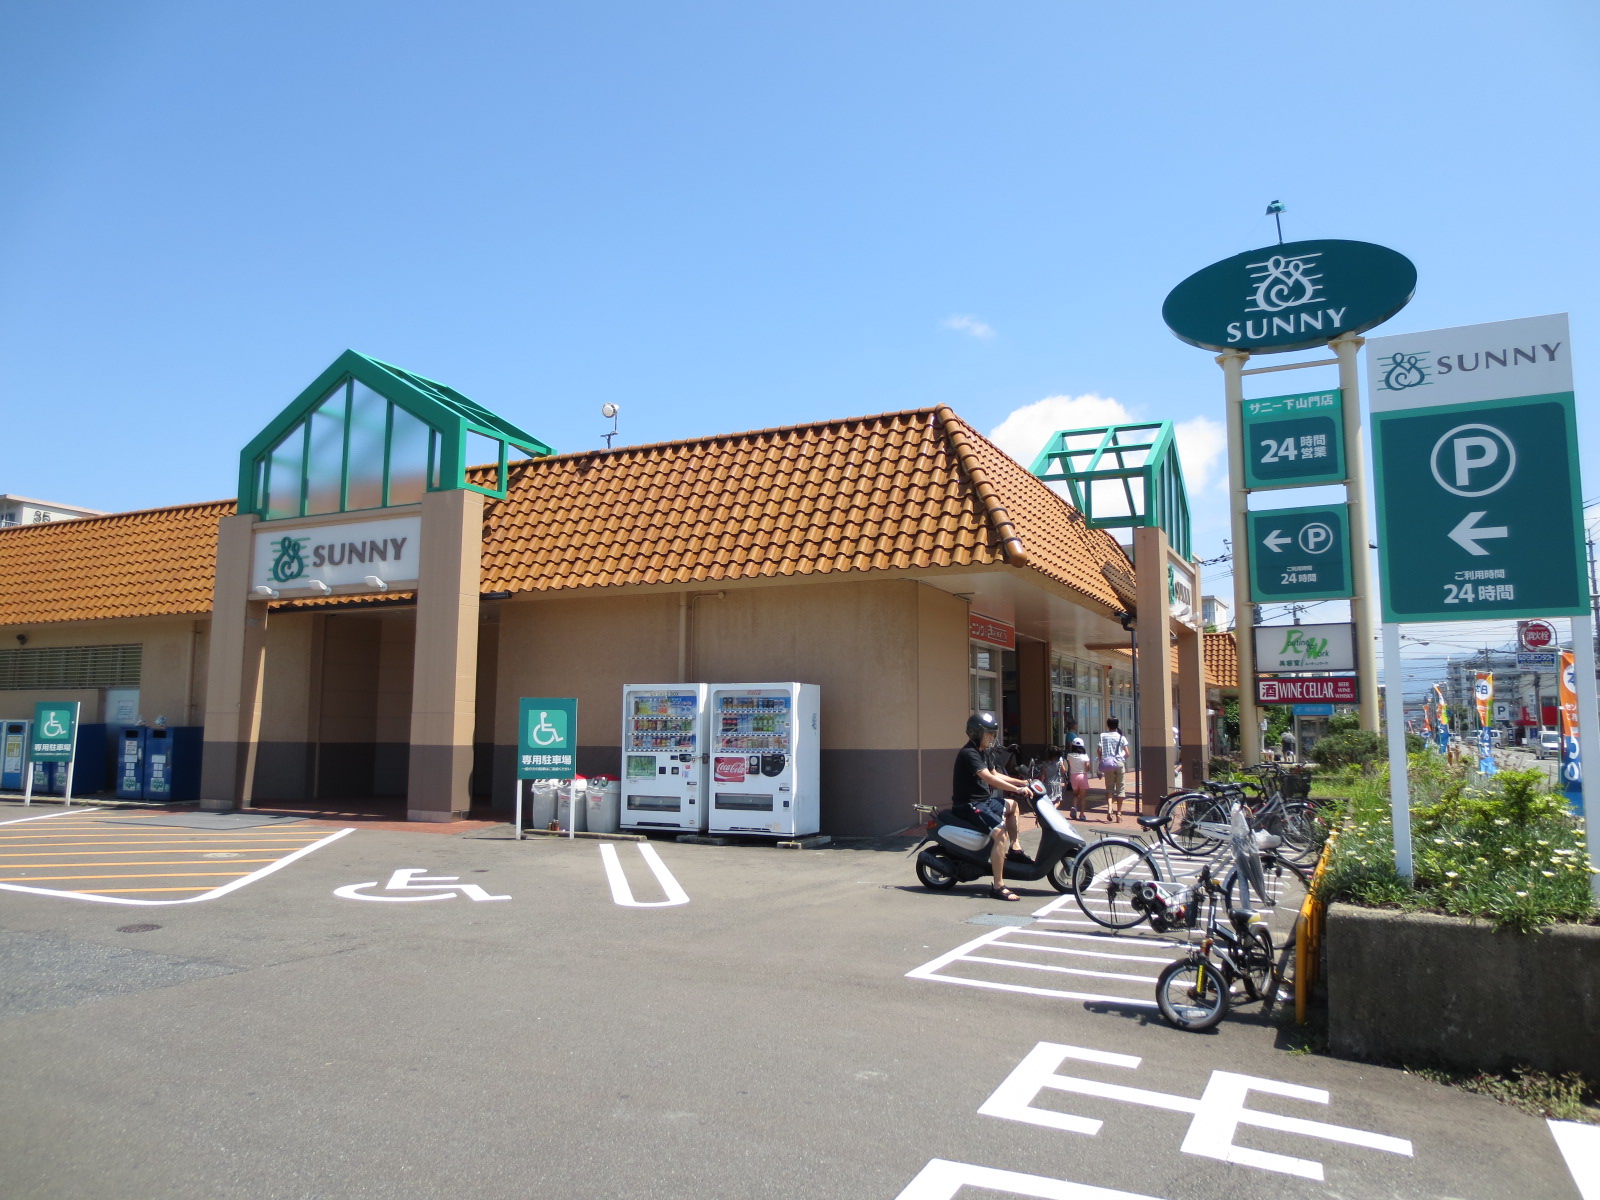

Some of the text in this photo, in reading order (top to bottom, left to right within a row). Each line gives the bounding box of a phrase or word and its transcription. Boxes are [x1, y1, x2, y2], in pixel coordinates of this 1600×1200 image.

[1226, 306, 1347, 343] SUNNY
[1436, 341, 1562, 375] SUNNY
[1248, 394, 1335, 414] サニー下山門店
[1260, 434, 1326, 464] 24 時間
[1300, 446, 1327, 460] 営業
[1453, 435, 1499, 487] P
[1308, 527, 1326, 550] P
[312, 537, 408, 567] SUNNY
[1280, 572, 1317, 585] 24 時間
[1454, 569, 1505, 581] ご利用時間
[1443, 583, 1514, 604] 24 時間
[1526, 631, 1550, 641] 消火栓
[1279, 659, 1300, 667] 美容室
[1262, 682, 1334, 699] 酒 WINE CELLAR
[1498, 706, 1506, 715] P
[34, 743, 71, 752] 専用駐車場
[521, 754, 572, 766] 専用駐車場
